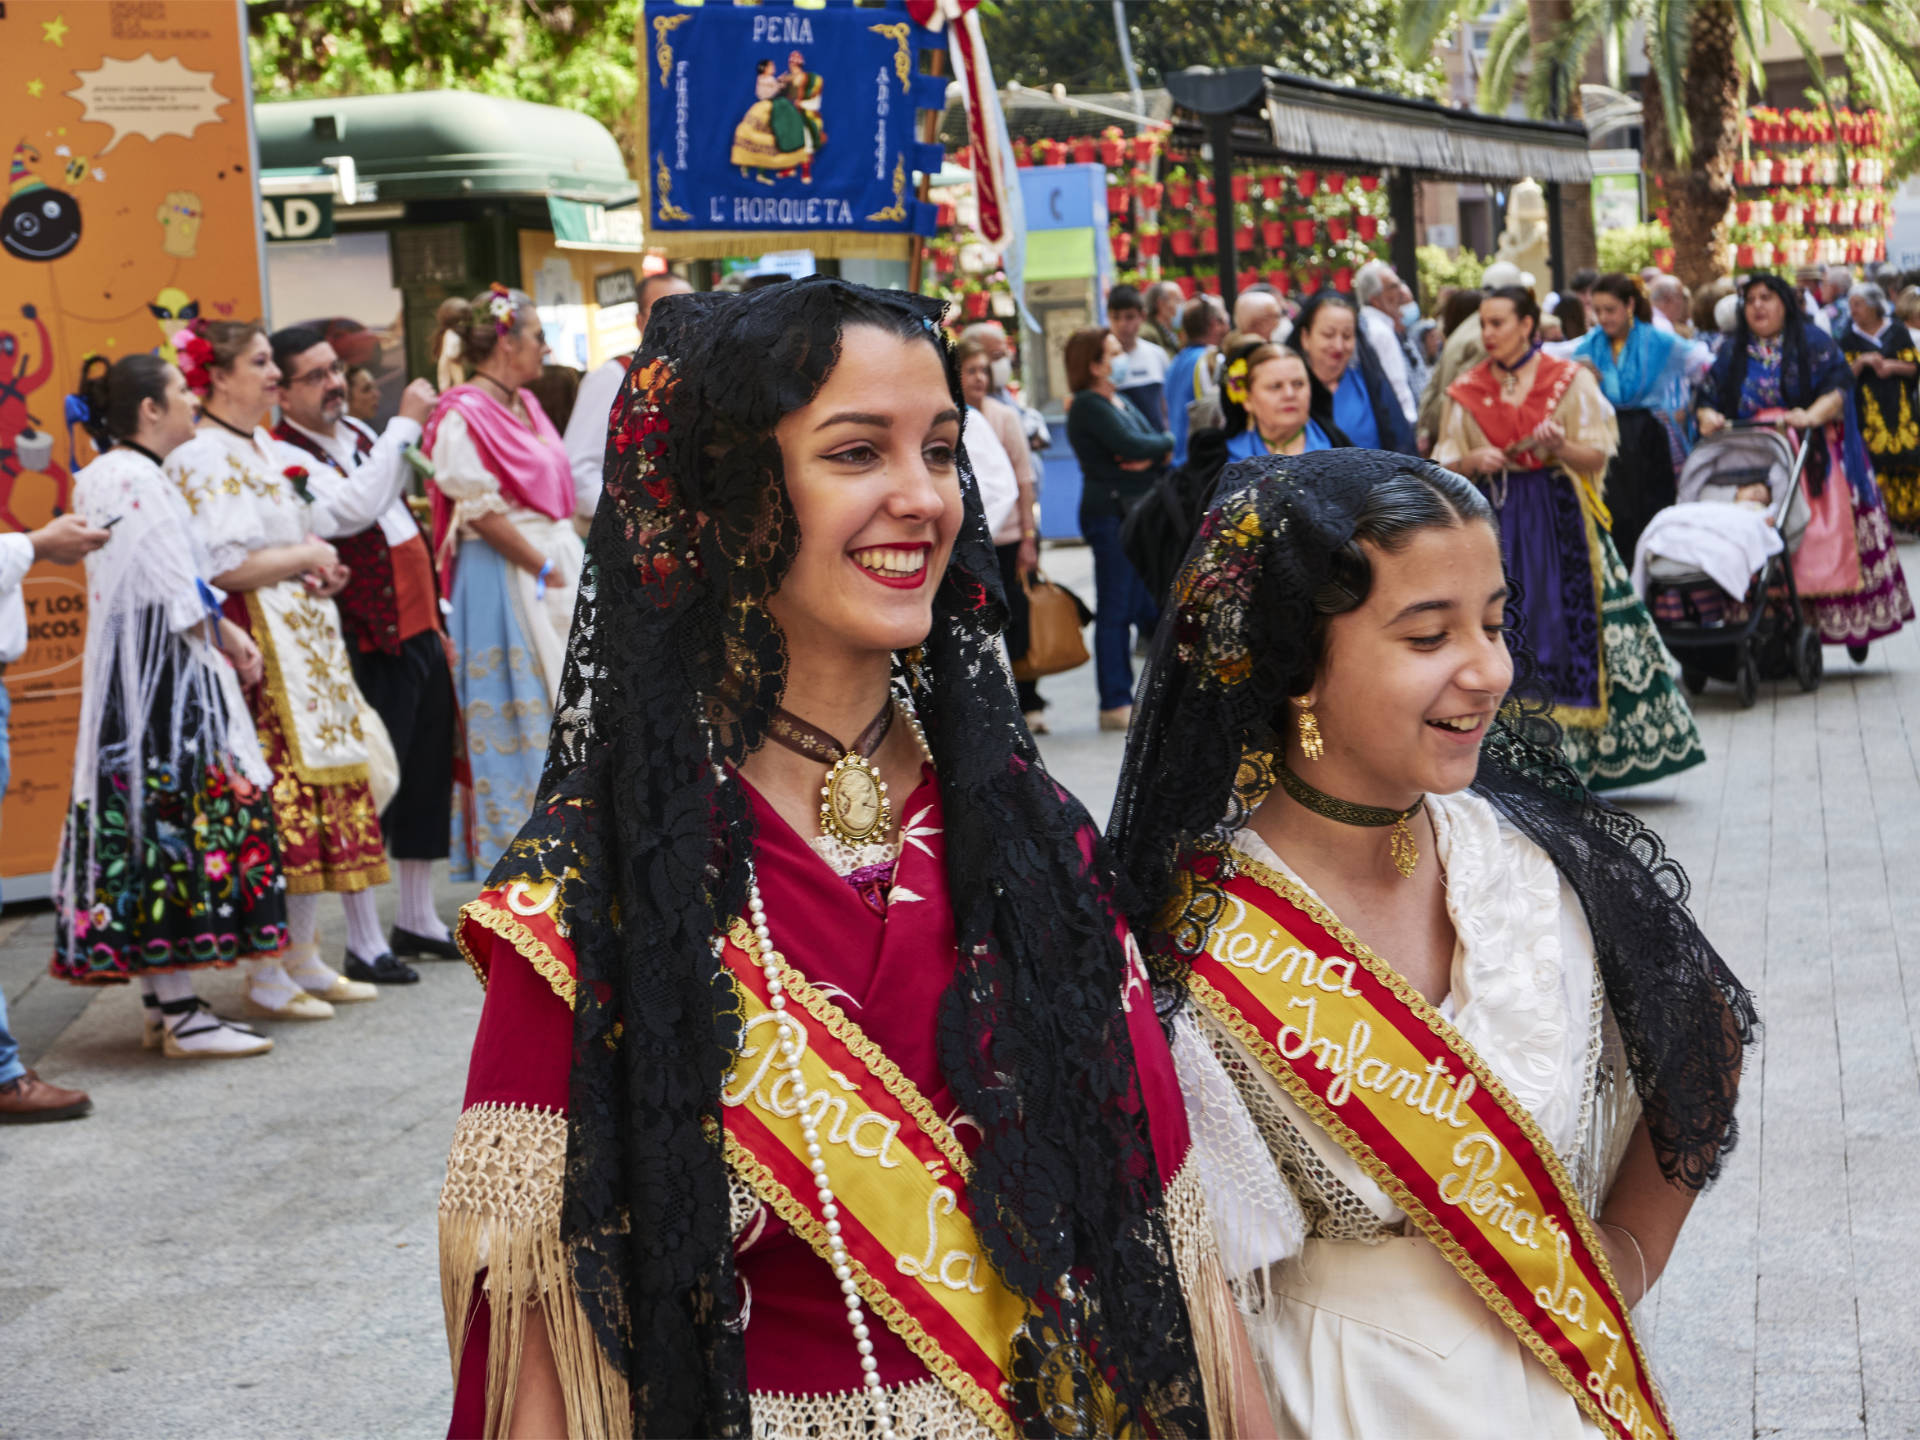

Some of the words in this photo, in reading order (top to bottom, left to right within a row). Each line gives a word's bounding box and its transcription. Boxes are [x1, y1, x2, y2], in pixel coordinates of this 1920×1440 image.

[752, 13, 814, 44] PEÑA
[733, 197, 854, 225] HORQUETA
[46, 595, 84, 615] LOS
[1194, 890, 1362, 998] Reina
[1275, 995, 1478, 1129] Infantil
[1437, 1131, 1542, 1250] Peña
